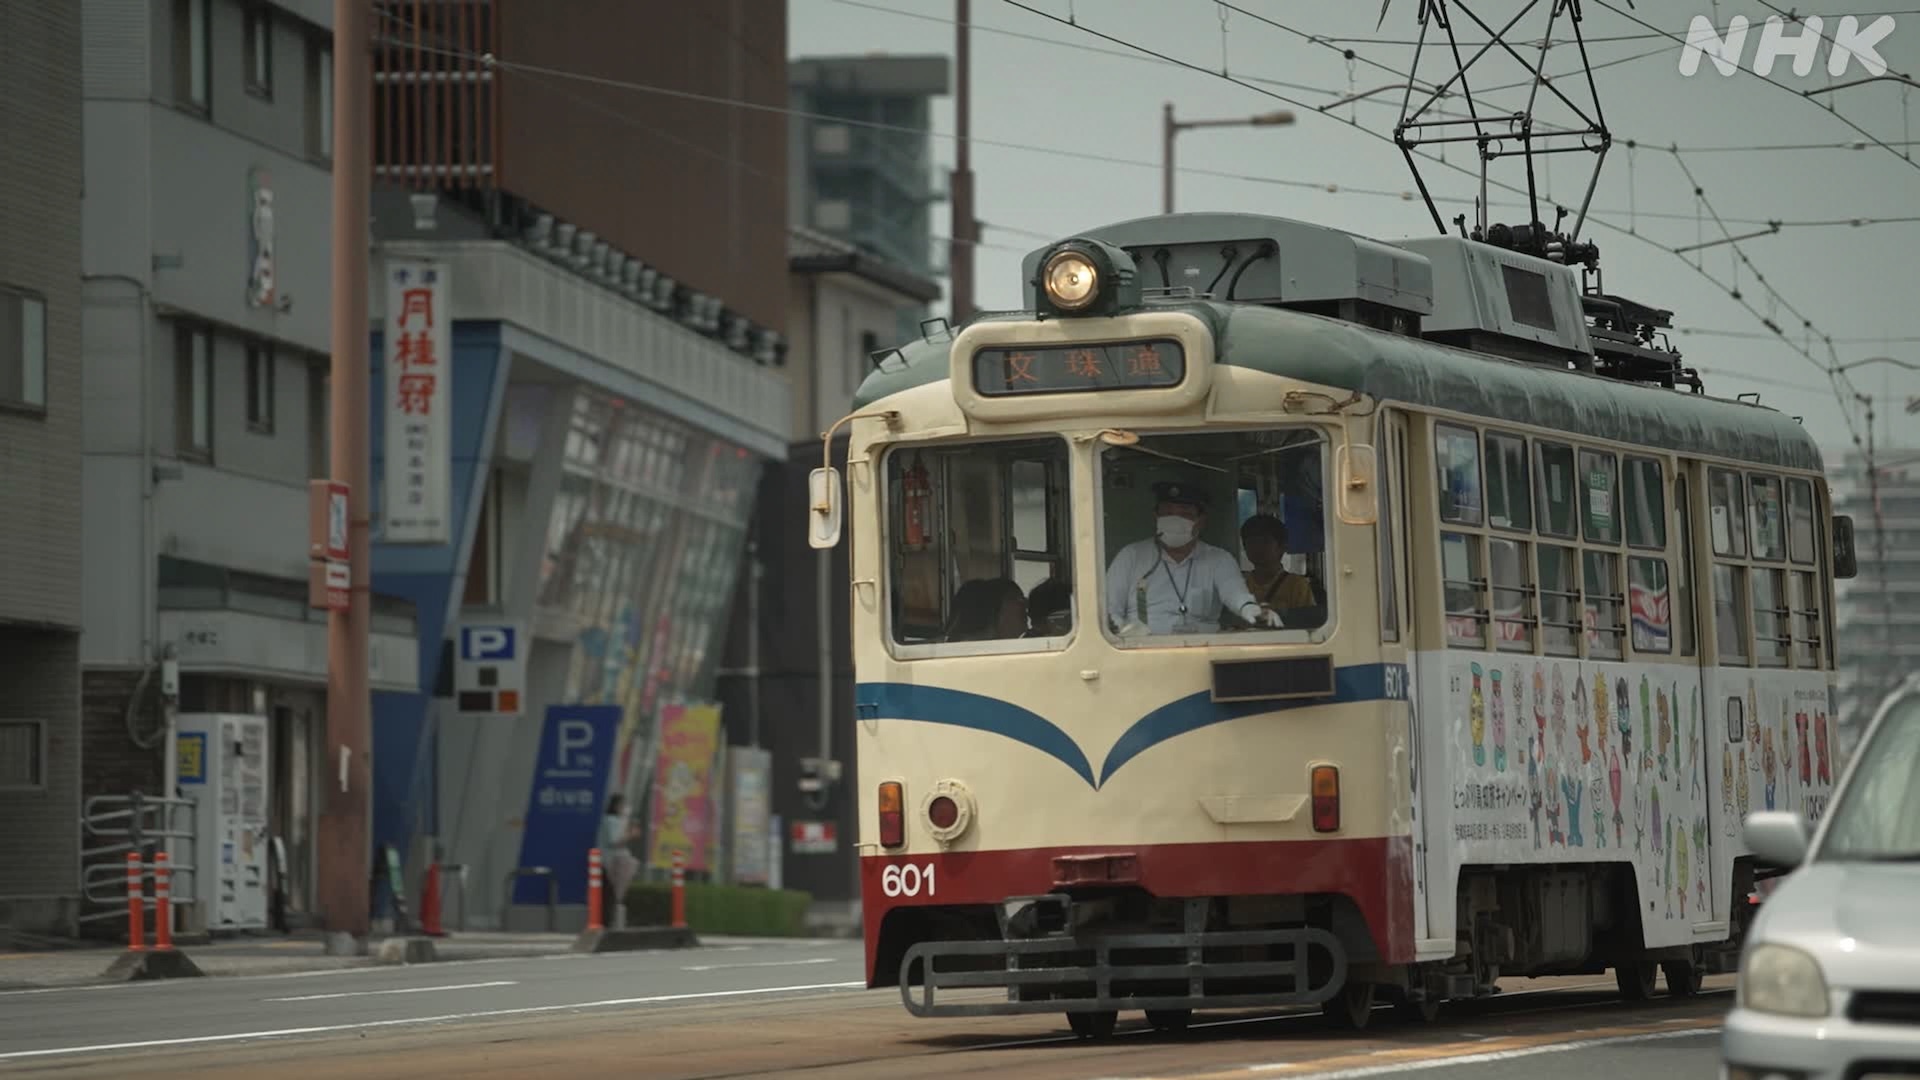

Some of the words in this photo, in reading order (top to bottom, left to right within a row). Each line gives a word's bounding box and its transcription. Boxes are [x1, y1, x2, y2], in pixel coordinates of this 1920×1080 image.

[1004, 348, 1164, 383] 文珠通
[469, 628, 508, 660] P
[1385, 666, 1403, 698] 601
[558, 720, 594, 767] P
[882, 863, 935, 897] 601
